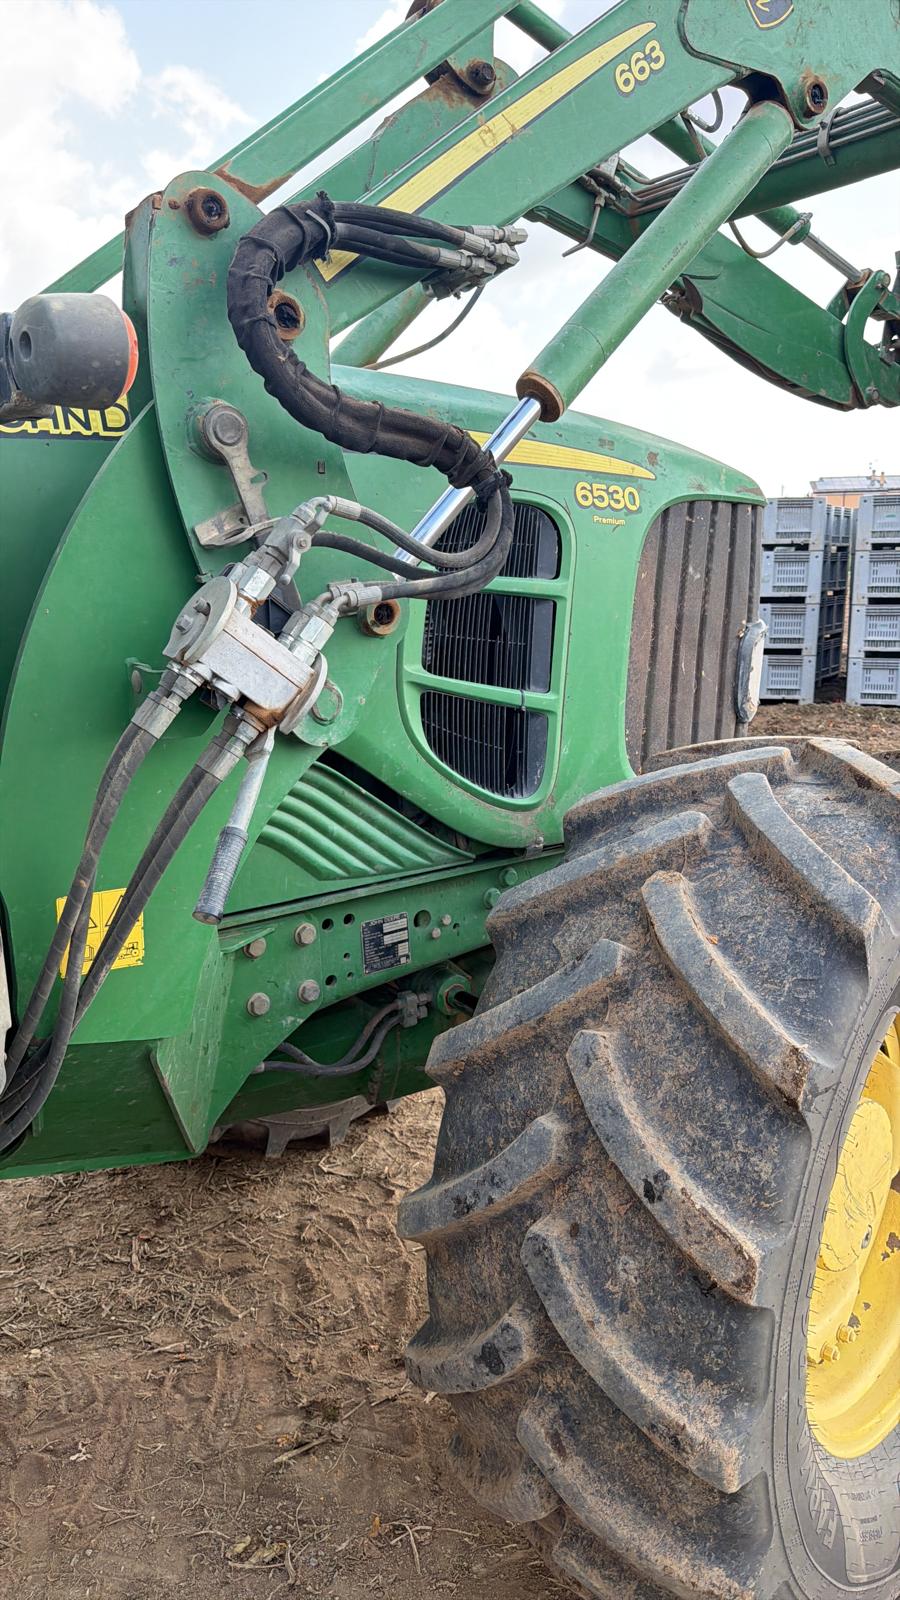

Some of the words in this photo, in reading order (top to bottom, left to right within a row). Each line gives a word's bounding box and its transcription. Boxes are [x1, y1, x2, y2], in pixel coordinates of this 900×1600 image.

[615, 39, 665, 93] 663
[575, 481, 640, 511] 6530
[593, 515, 625, 525] Premium
